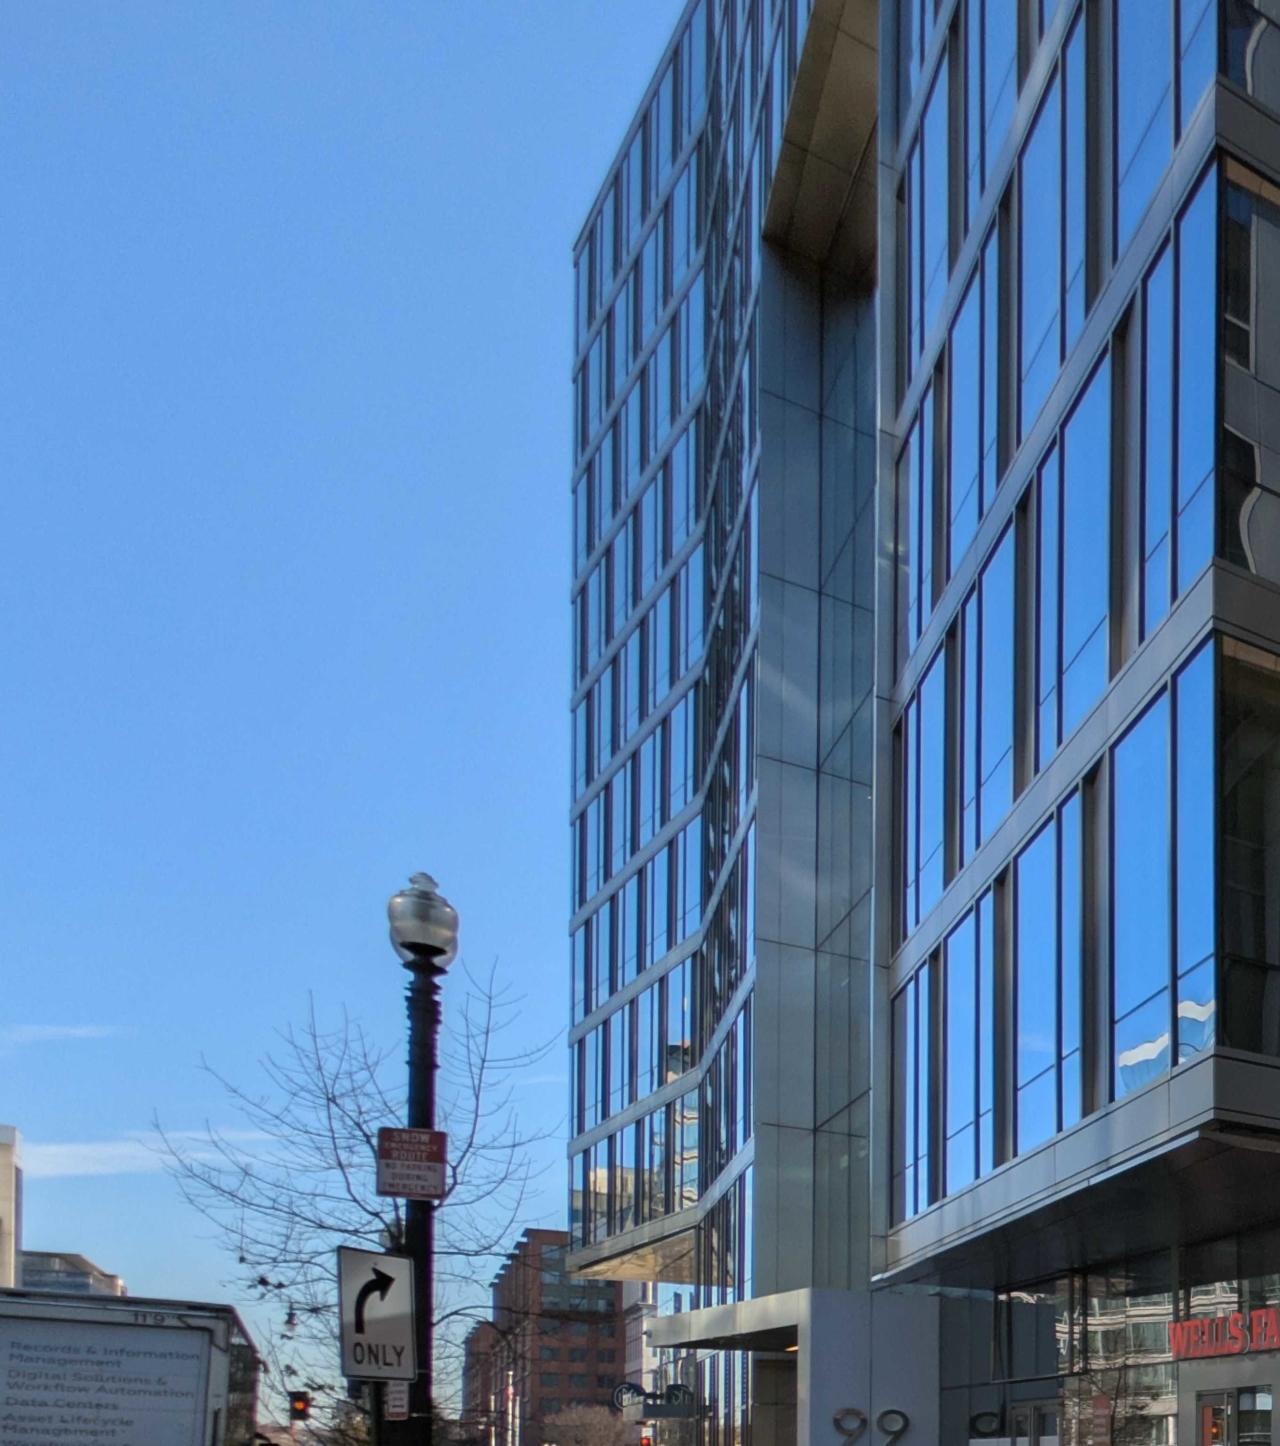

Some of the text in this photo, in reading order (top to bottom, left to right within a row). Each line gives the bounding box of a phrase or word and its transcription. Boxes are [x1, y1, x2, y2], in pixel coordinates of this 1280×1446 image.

[392, 1131, 431, 1144] SNOW
[391, 1149, 430, 1161] ROUTE
[1168, 1312, 1250, 1360] WELLS
[10, 1341, 200, 1361] Records & Information
[353, 1342, 405, 1367] ONLY
[9, 1353, 122, 1368] Management
[7, 1369, 168, 1386] Digital Solutions &
[5, 1381, 195, 1399] Workflow Automation
[3, 1396, 120, 1410] Data Centers
[1, 1412, 135, 1428] Asset Lifecycle
[1, 1424, 117, 1438] Management
